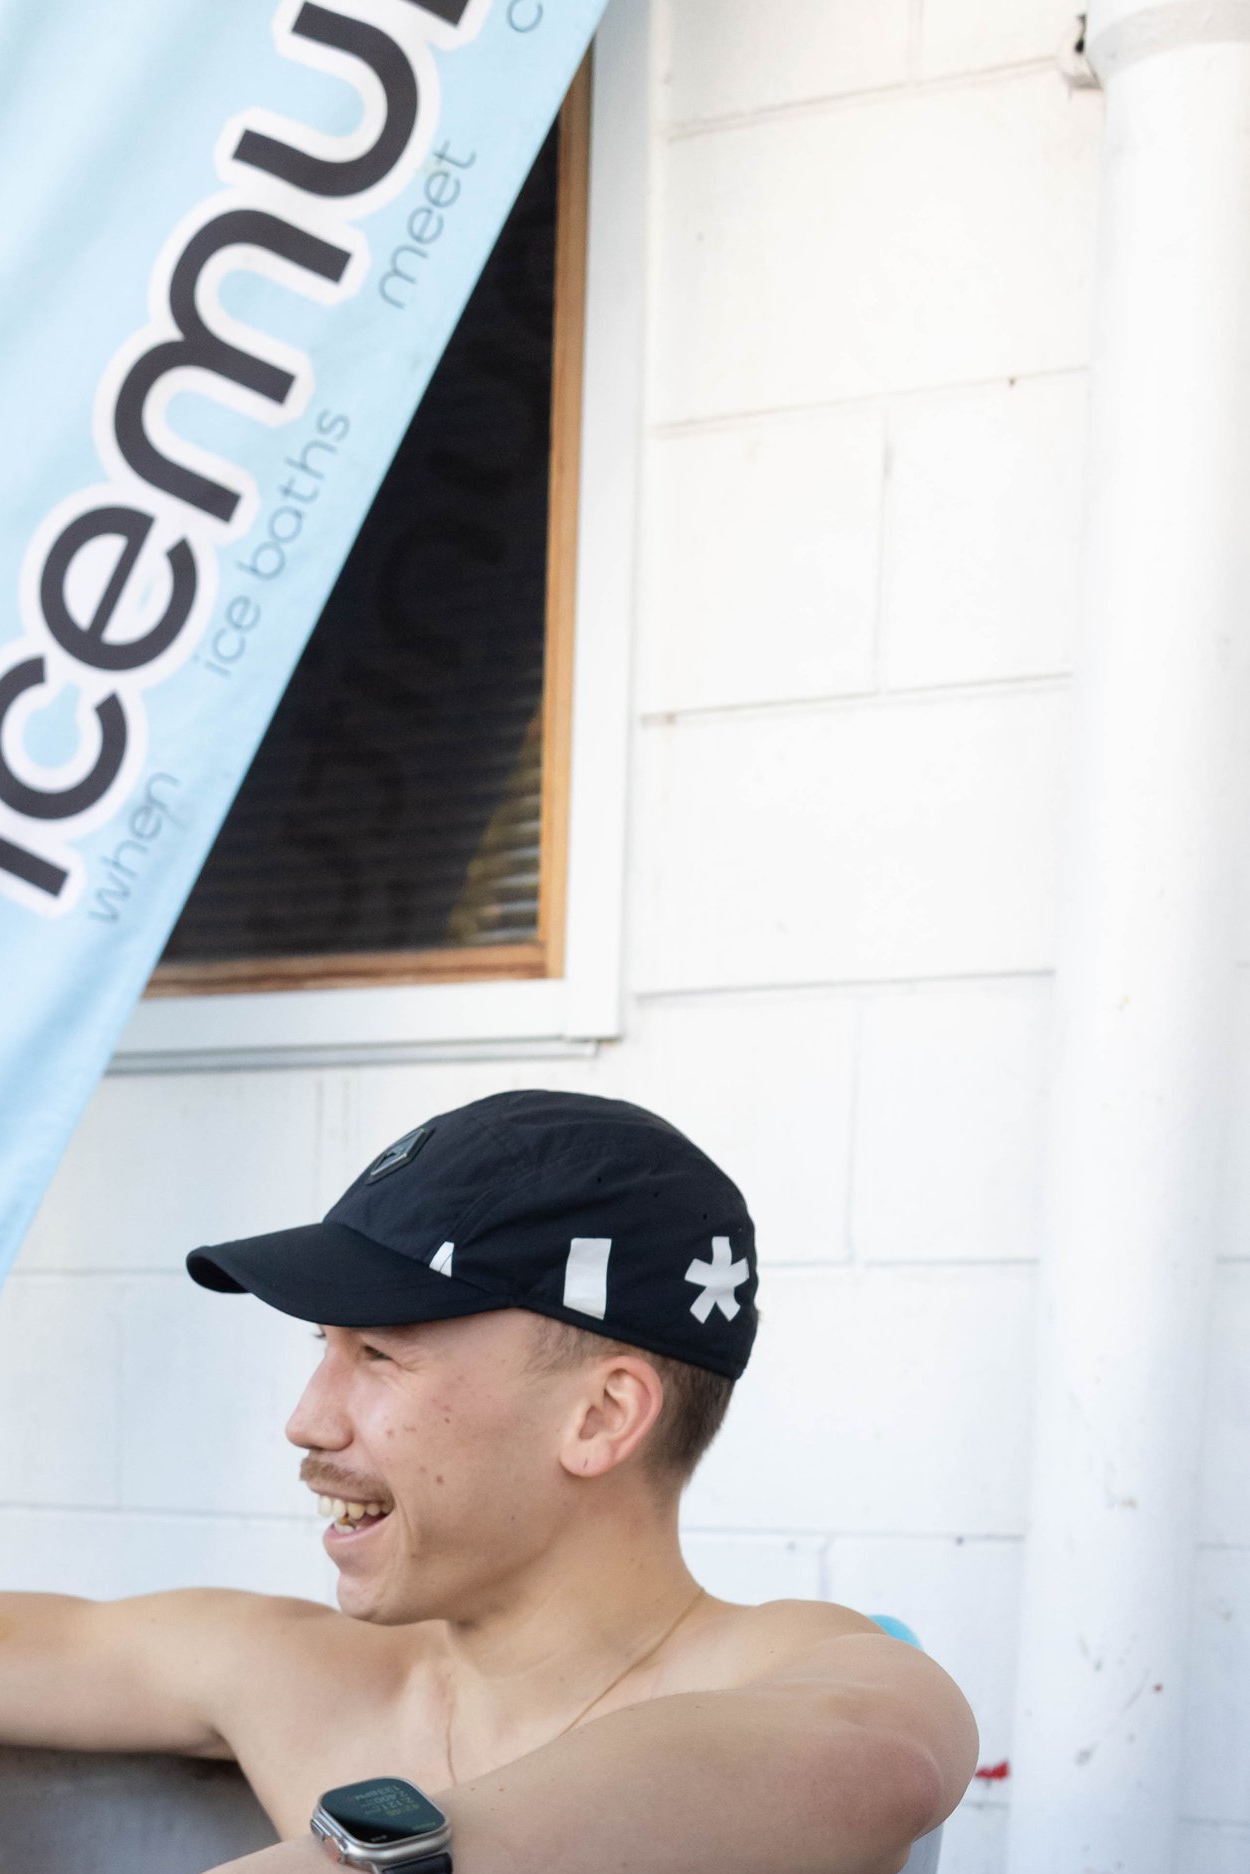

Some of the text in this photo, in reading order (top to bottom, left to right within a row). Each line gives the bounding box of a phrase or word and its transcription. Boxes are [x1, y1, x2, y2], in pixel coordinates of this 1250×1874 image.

[88, 770, 181, 925] when
[194, 595, 261, 679] ice
[236, 407, 351, 581] baths
[378, 140, 477, 310] meet
